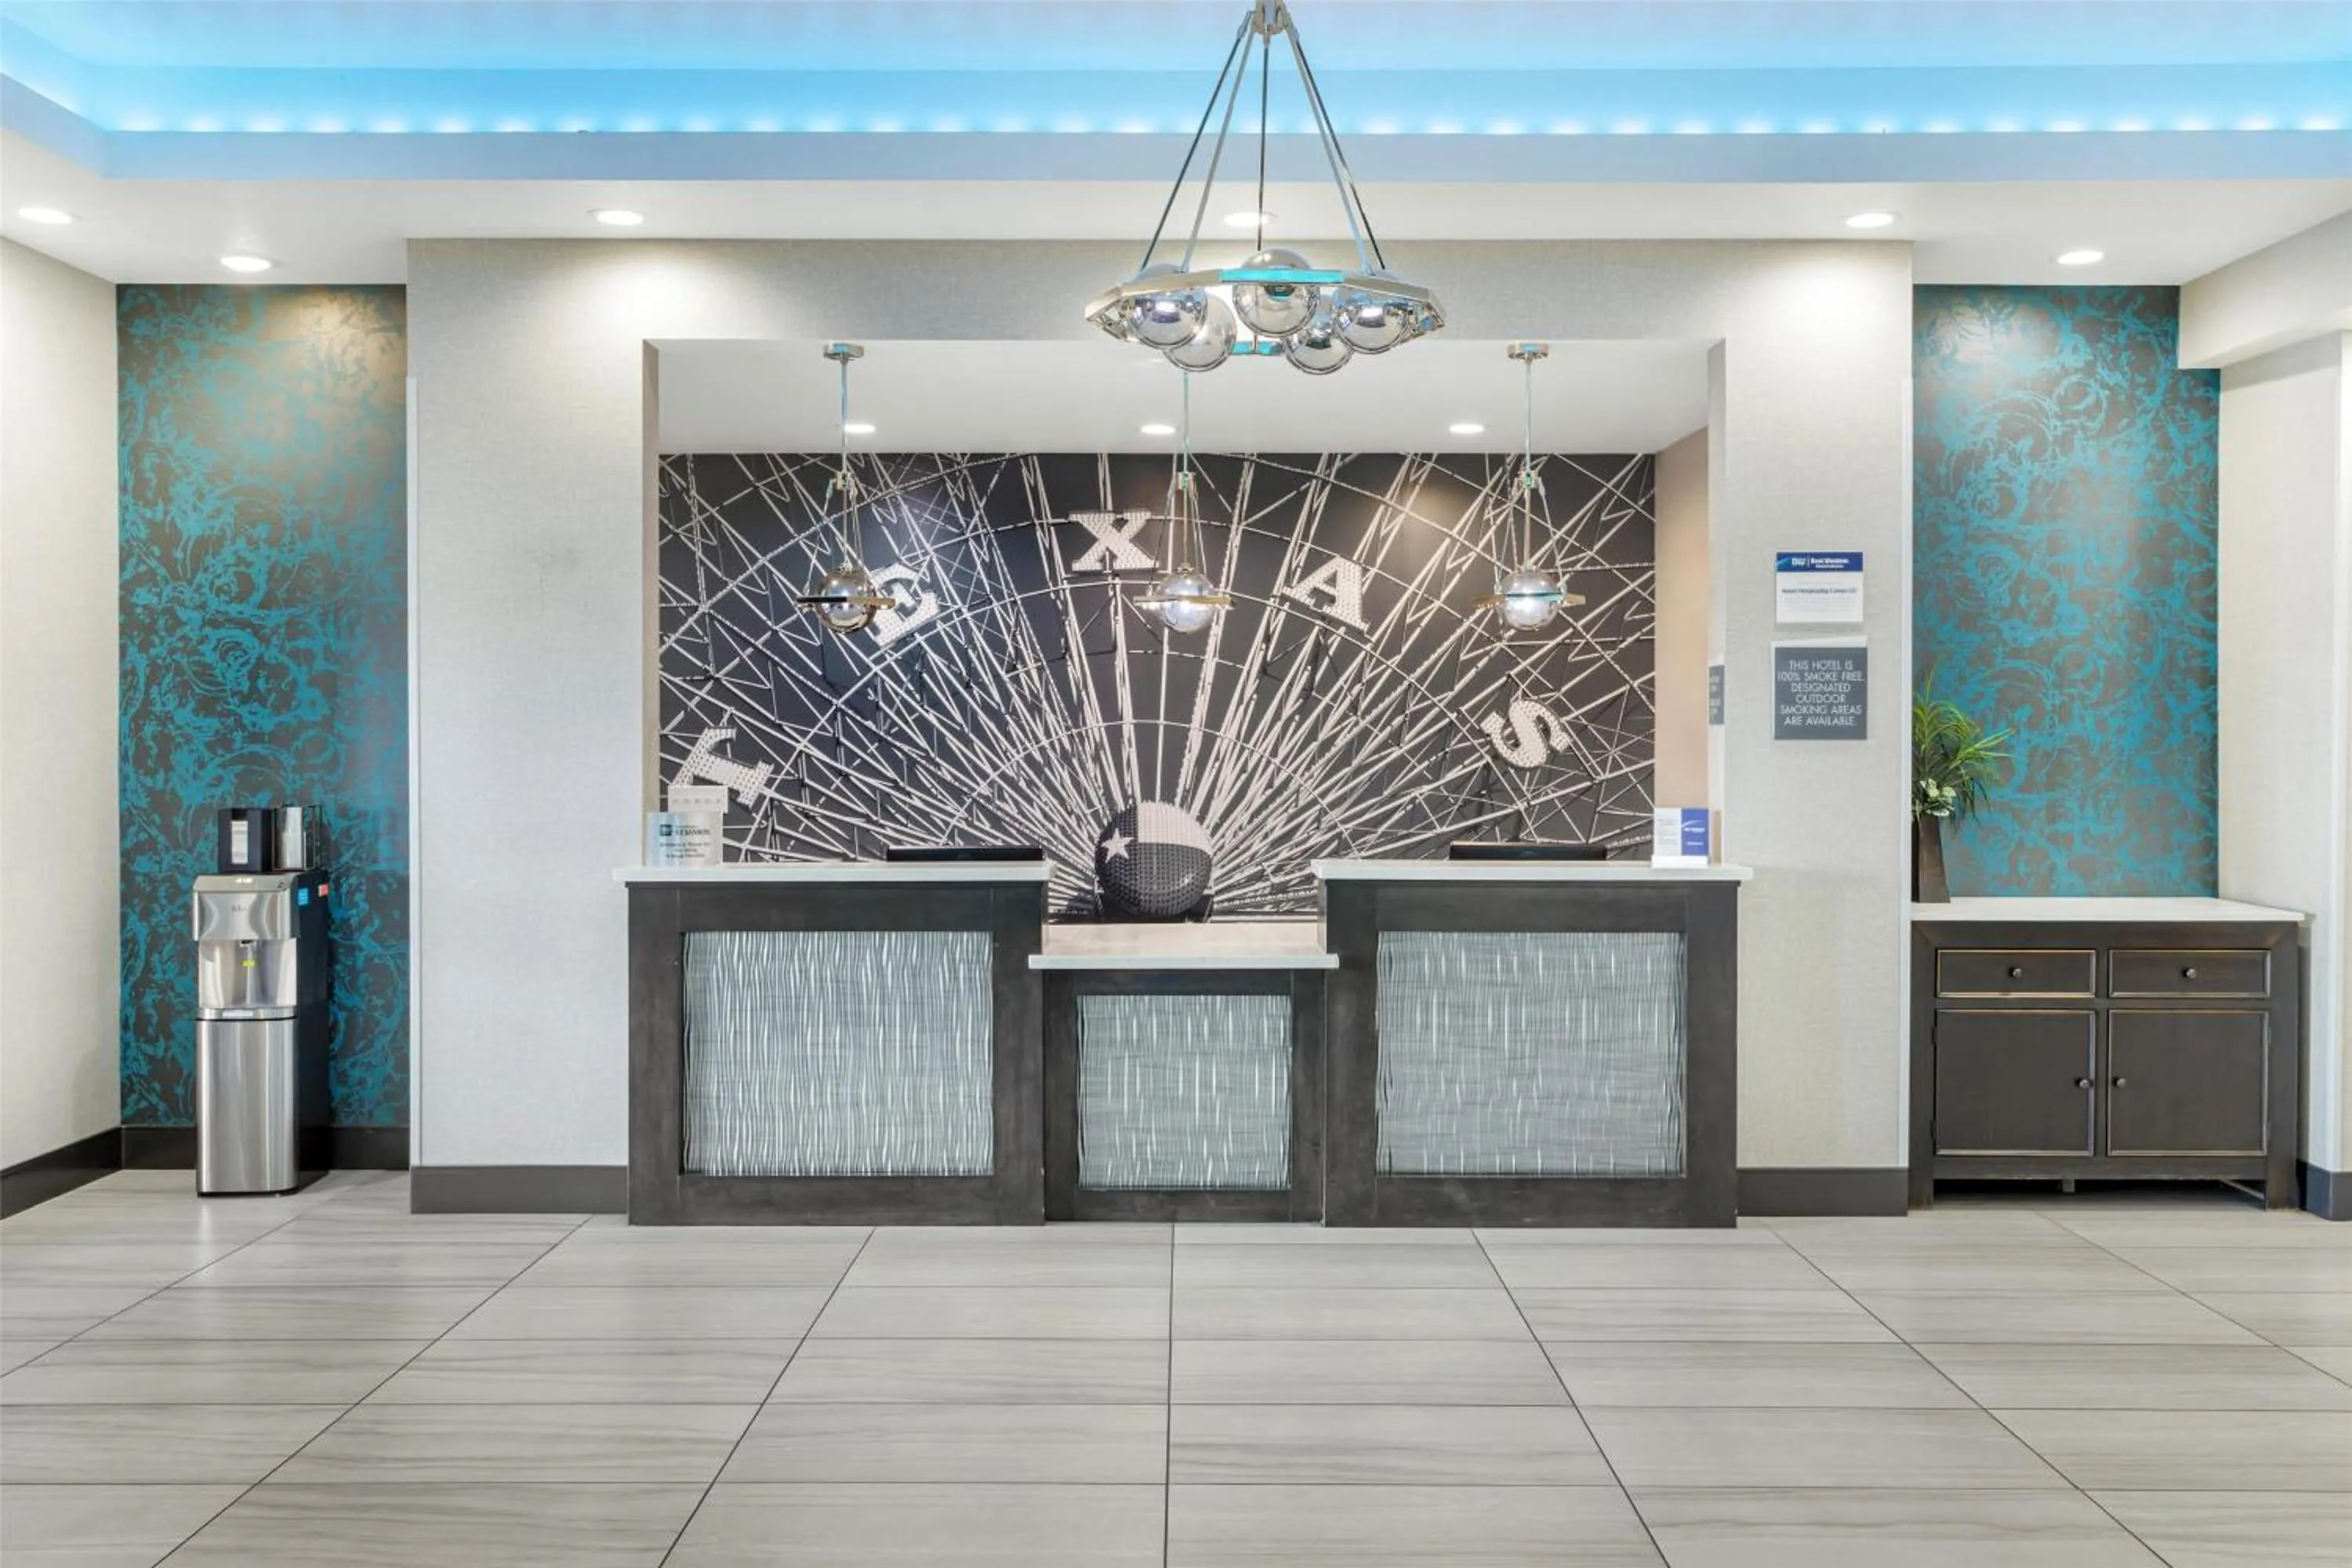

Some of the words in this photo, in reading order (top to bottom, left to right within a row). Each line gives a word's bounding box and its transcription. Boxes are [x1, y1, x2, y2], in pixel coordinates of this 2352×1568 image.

[1788, 659, 1809, 670] THIS
[1812, 659, 1842, 670] HOTEL
[1845, 659, 1853, 670] IS
[1777, 671, 1801, 682] 100%
[1804, 671, 1838, 681] SMOKE
[1791, 682, 1851, 692] DESIGNATED
[1795, 694, 1846, 703] OUTDOOR
[1780, 705, 1828, 714] SMOKING
[1831, 705, 1863, 715] AREAS
[1784, 716, 1802, 726] ARE
